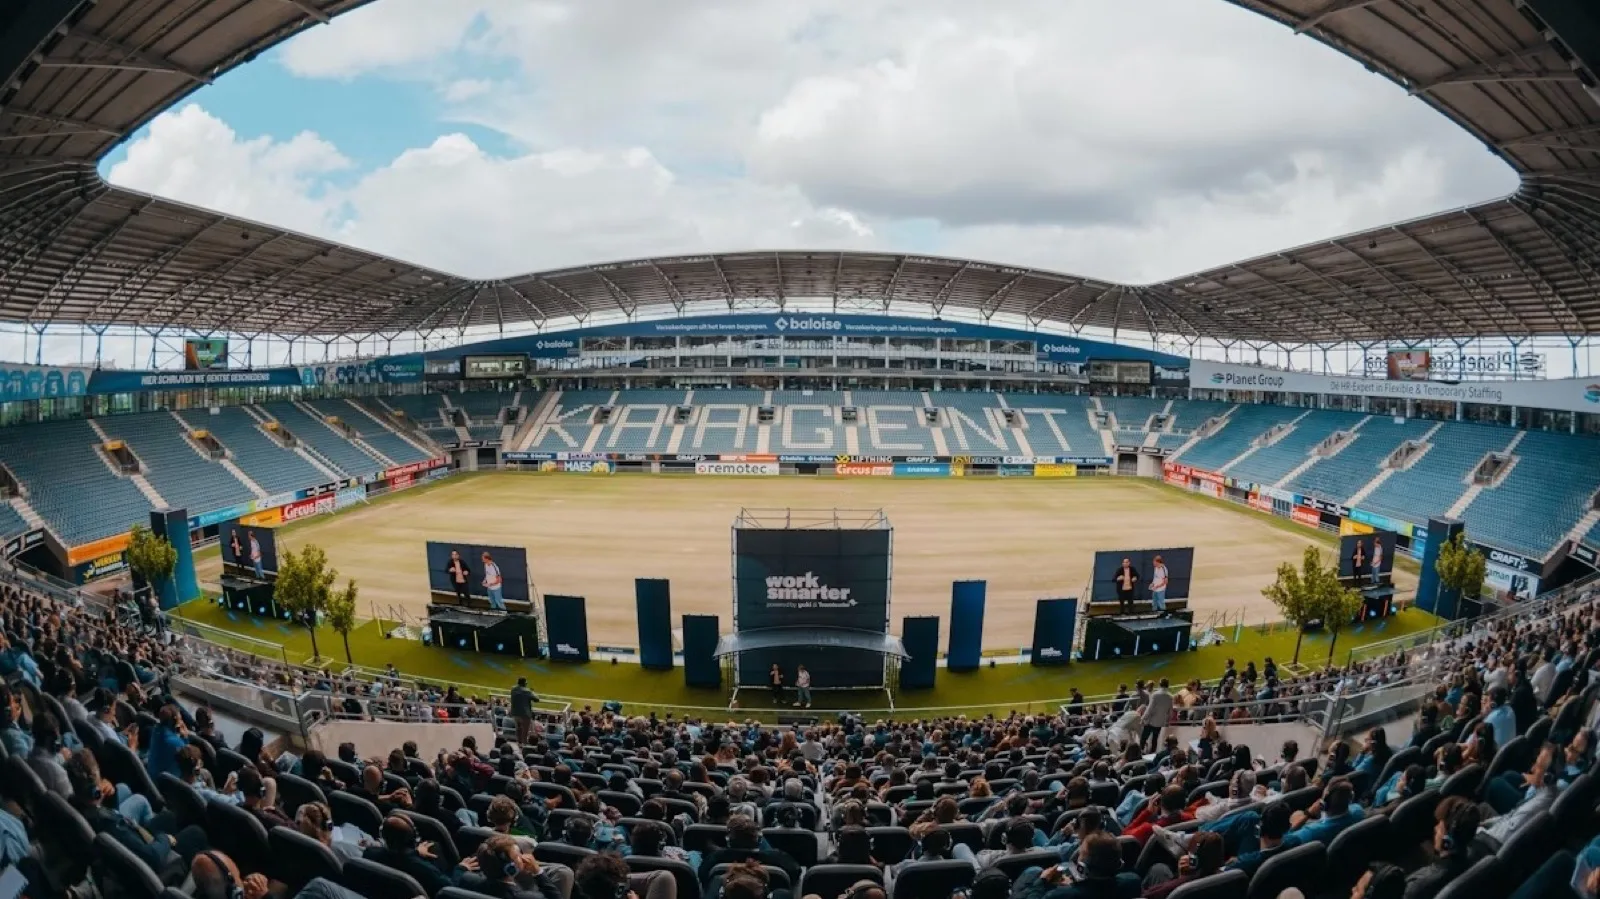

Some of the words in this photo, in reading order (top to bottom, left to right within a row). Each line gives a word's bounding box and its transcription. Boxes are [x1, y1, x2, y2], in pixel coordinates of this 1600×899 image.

[790, 316, 841, 330] baloise
[544, 339, 574, 349] baloise
[1051, 344, 1080, 354] baloise
[1226, 373, 1257, 385] Planet
[1258, 374, 1284, 389] Group
[1376, 383, 1383, 391] in
[1385, 382, 1414, 394] Flexible
[1415, 384, 1421, 394] &
[1424, 384, 1467, 398] Temporary
[1468, 386, 1502, 402] Staffing
[564, 461, 592, 473] MAES
[707, 463, 767, 474] remotec
[836, 464, 871, 475] Circus
[1490, 550, 1519, 567] CRAFT
[765, 571, 819, 588] work
[766, 584, 851, 600] smarter
